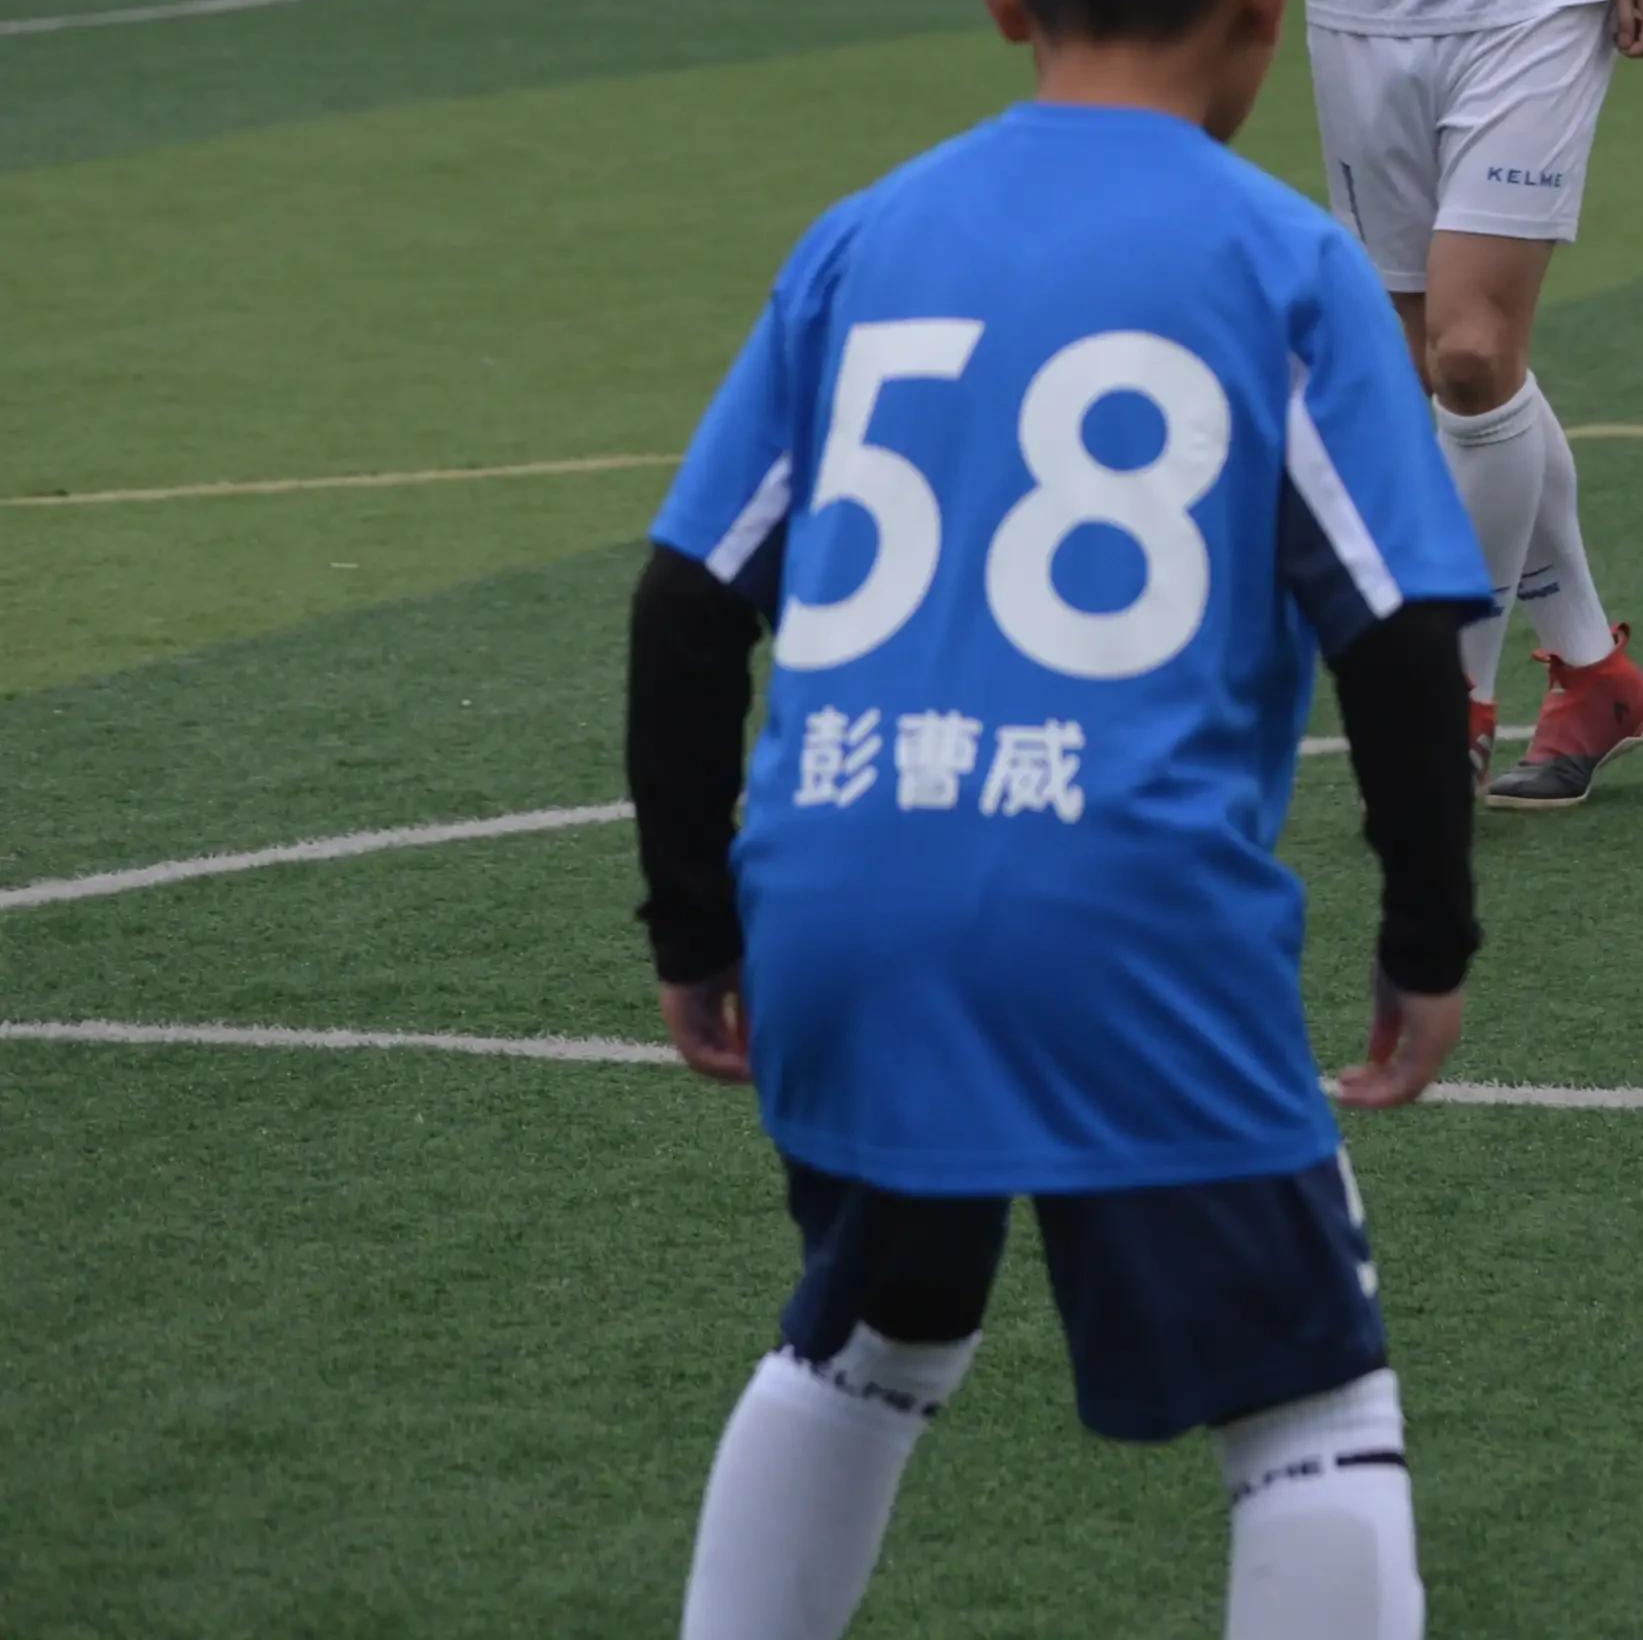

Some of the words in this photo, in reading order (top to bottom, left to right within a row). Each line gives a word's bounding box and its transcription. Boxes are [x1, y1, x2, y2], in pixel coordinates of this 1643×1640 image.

[1486, 166, 1563, 189] KELME
[773, 317, 1232, 680] 58
[793, 705, 1086, 824] 彭曹威
